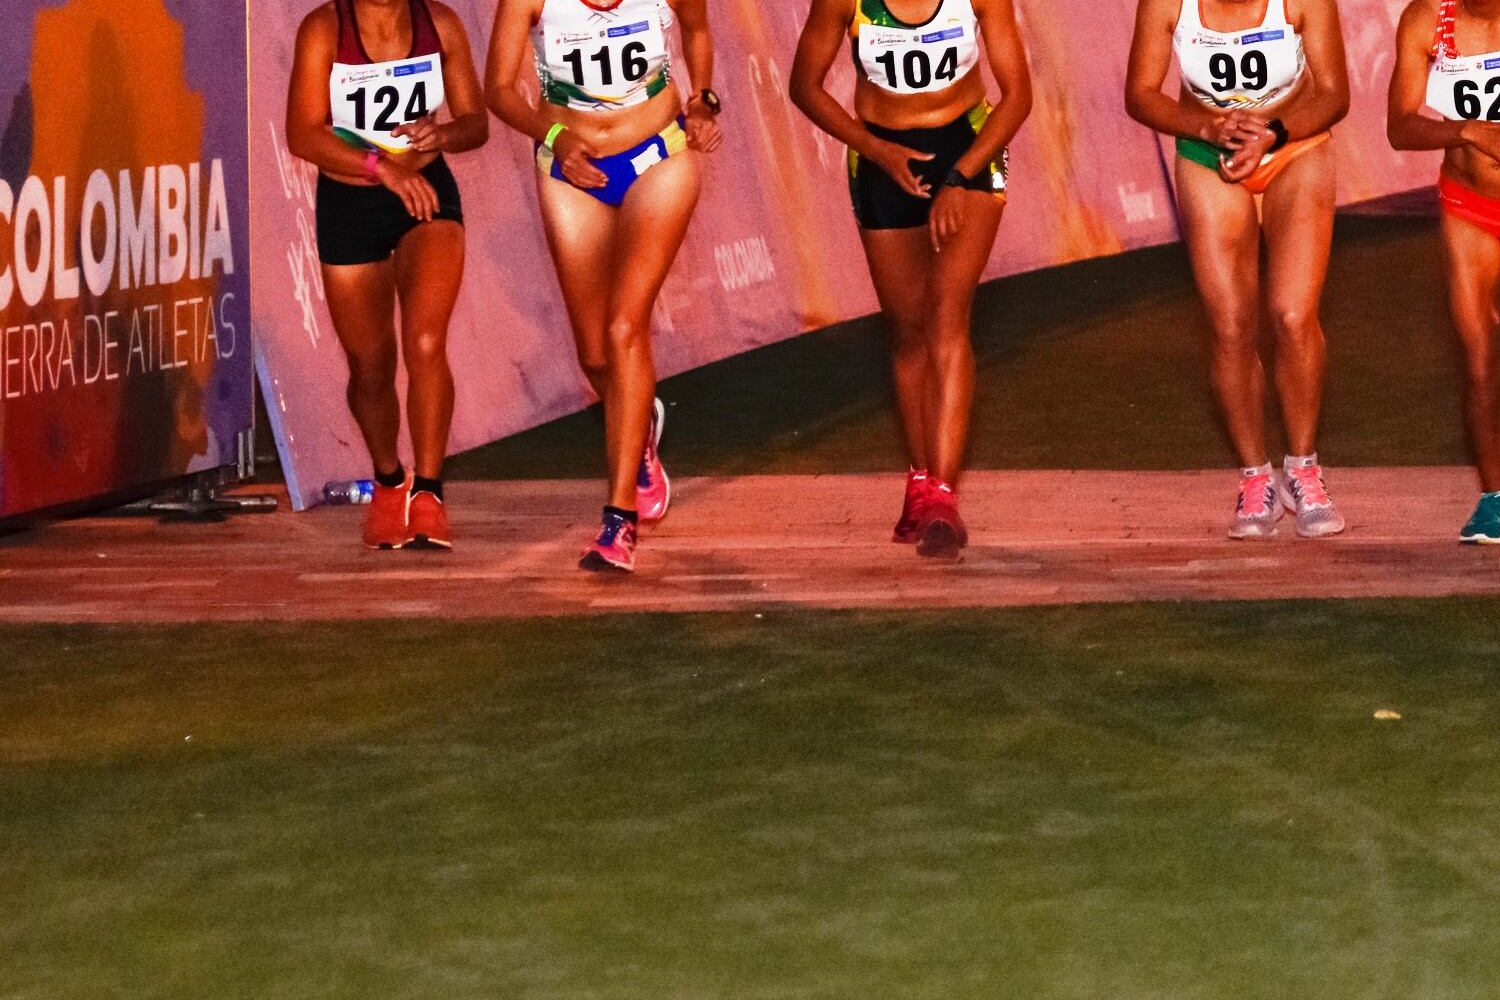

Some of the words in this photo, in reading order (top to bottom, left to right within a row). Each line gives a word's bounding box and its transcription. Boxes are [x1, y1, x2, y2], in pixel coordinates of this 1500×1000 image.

[562, 41, 649, 86] 116
[875, 46, 959, 89] 104
[1208, 49, 1268, 93] 99
[346, 81, 430, 132] 124
[0, 317, 76, 400] IERRA
[83, 309, 119, 385] DE
[126, 292, 236, 377] ATLETAS
